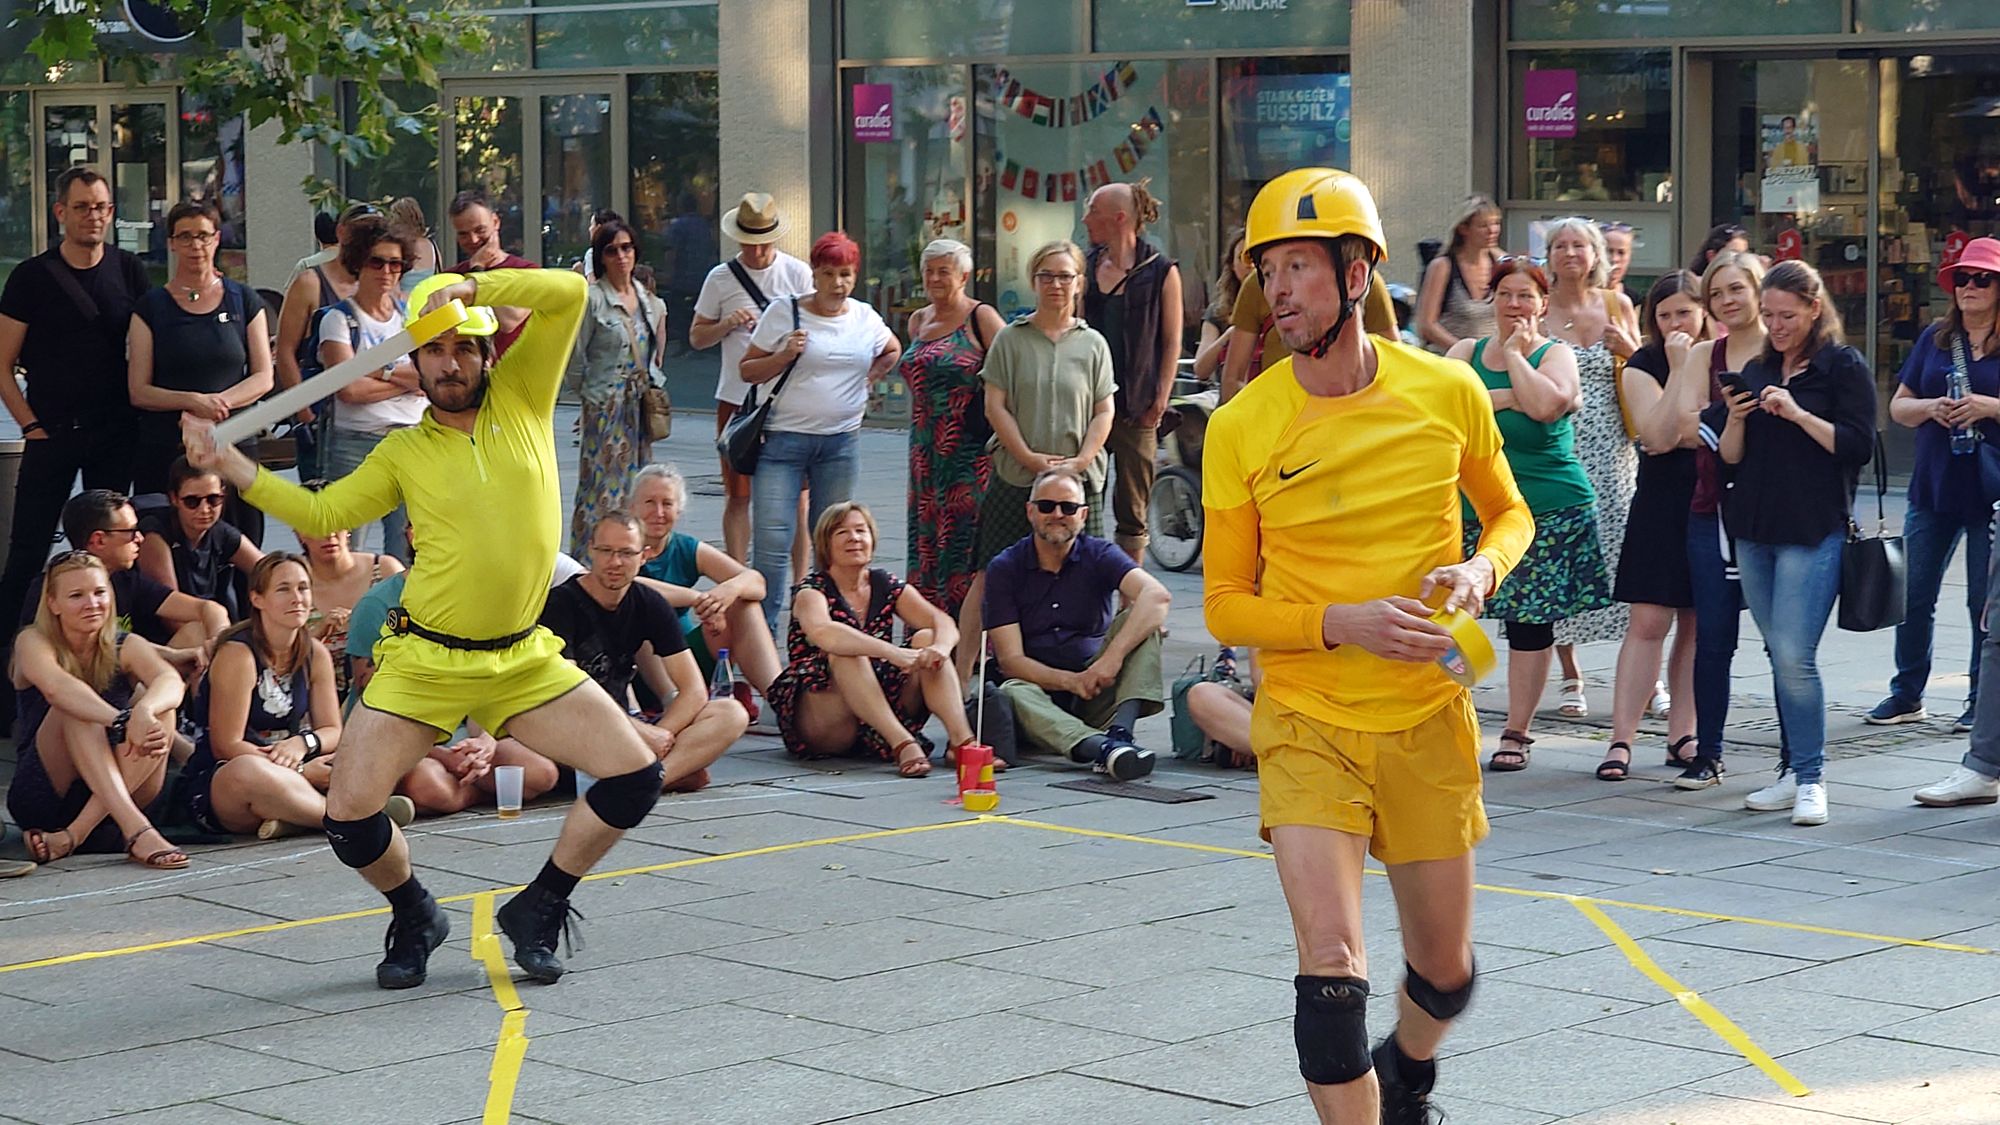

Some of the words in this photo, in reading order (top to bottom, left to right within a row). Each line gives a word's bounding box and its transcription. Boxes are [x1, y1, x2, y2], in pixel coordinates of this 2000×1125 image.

[1221, 0, 1288, 11] SKINCARE
[1257, 90, 1295, 104] STARK
[1296, 88, 1336, 102] GEGEN
[1257, 103, 1336, 122] FUSSPILZ
[1525, 100, 1576, 121] curadies
